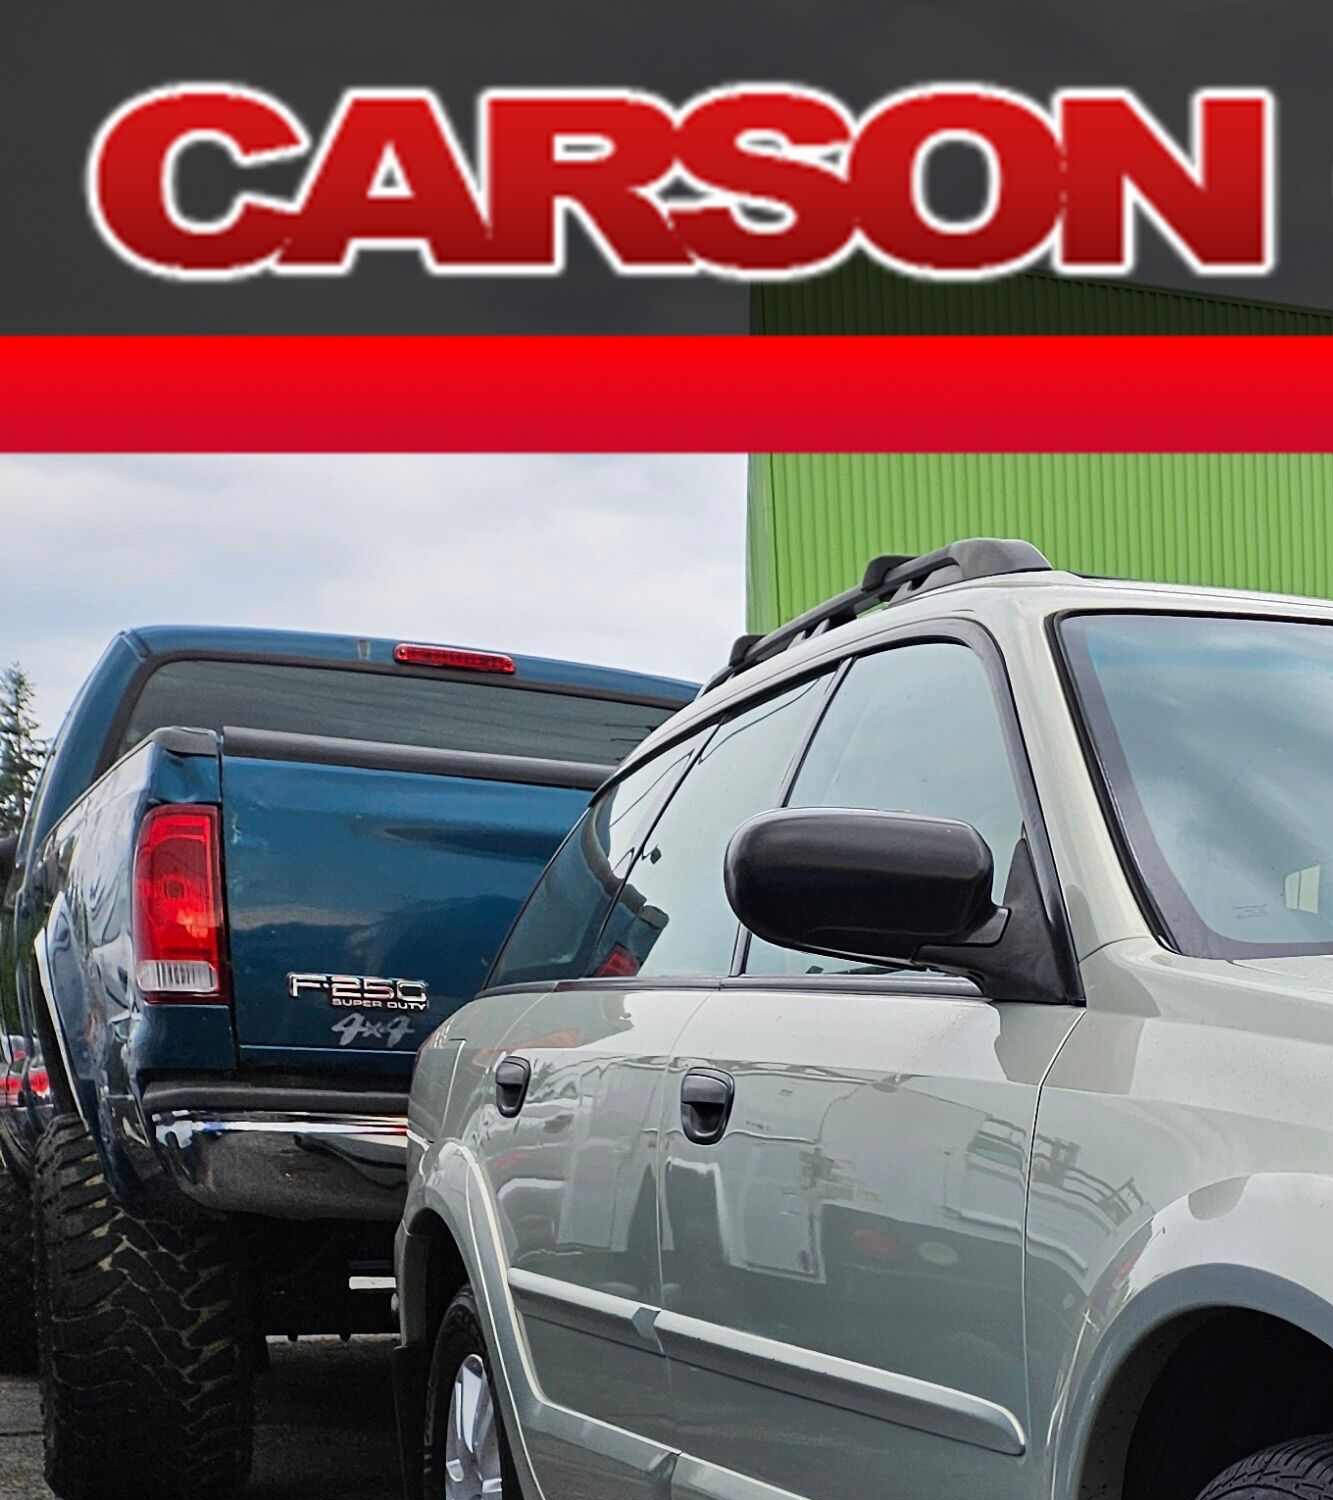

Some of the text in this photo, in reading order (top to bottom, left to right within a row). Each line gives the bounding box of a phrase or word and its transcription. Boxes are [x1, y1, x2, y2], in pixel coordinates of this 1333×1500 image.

[331, 998, 427, 1011] SUPER DUTY
[331, 1012, 416, 1048] 4x4
